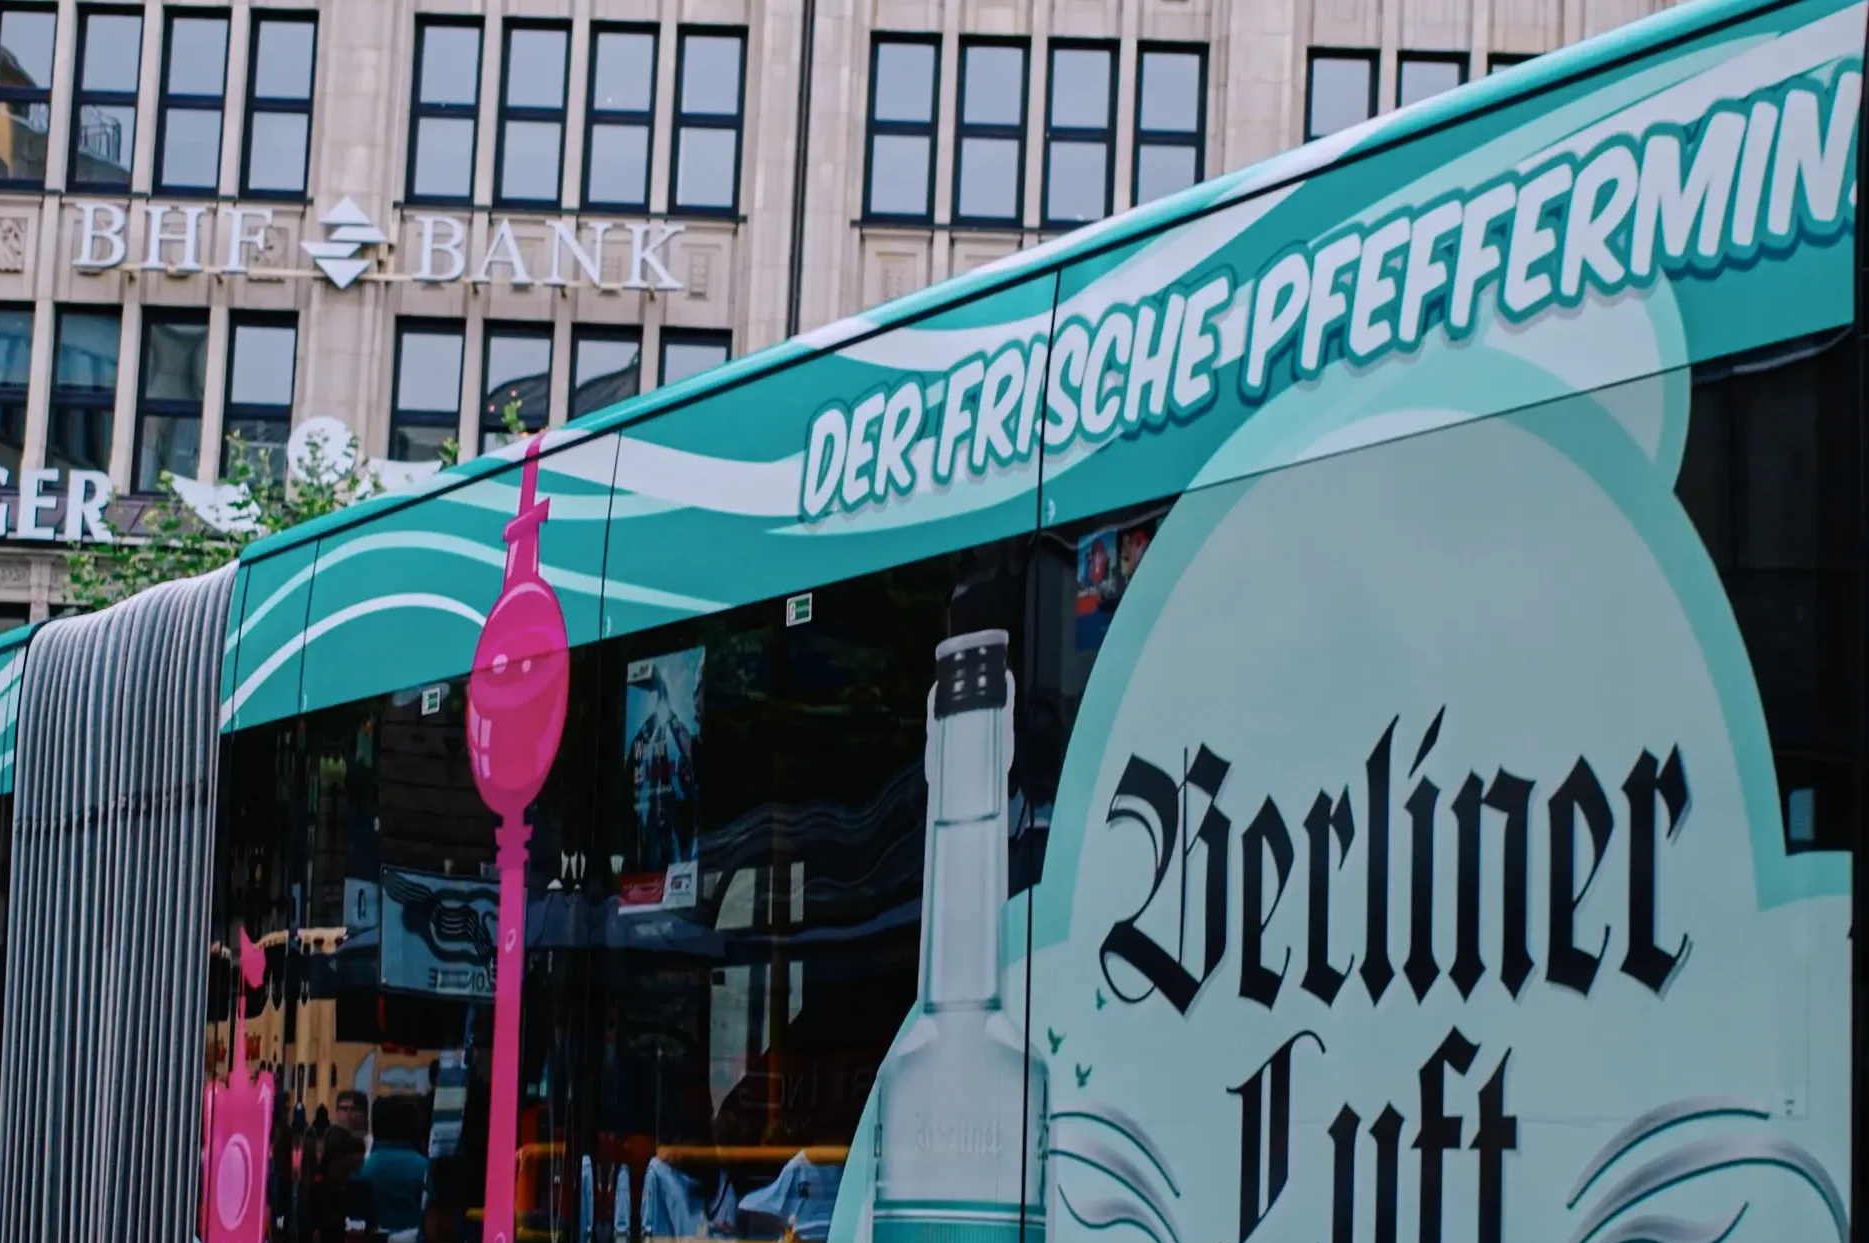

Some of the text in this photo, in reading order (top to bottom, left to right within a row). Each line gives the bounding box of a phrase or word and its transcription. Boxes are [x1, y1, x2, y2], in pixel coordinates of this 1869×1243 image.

[72, 202, 685, 290] BHF BANK
[803, 70, 1863, 517] DER FRISCHE PFEFFERMIN
[1099, 704, 1693, 1018] Berliner
